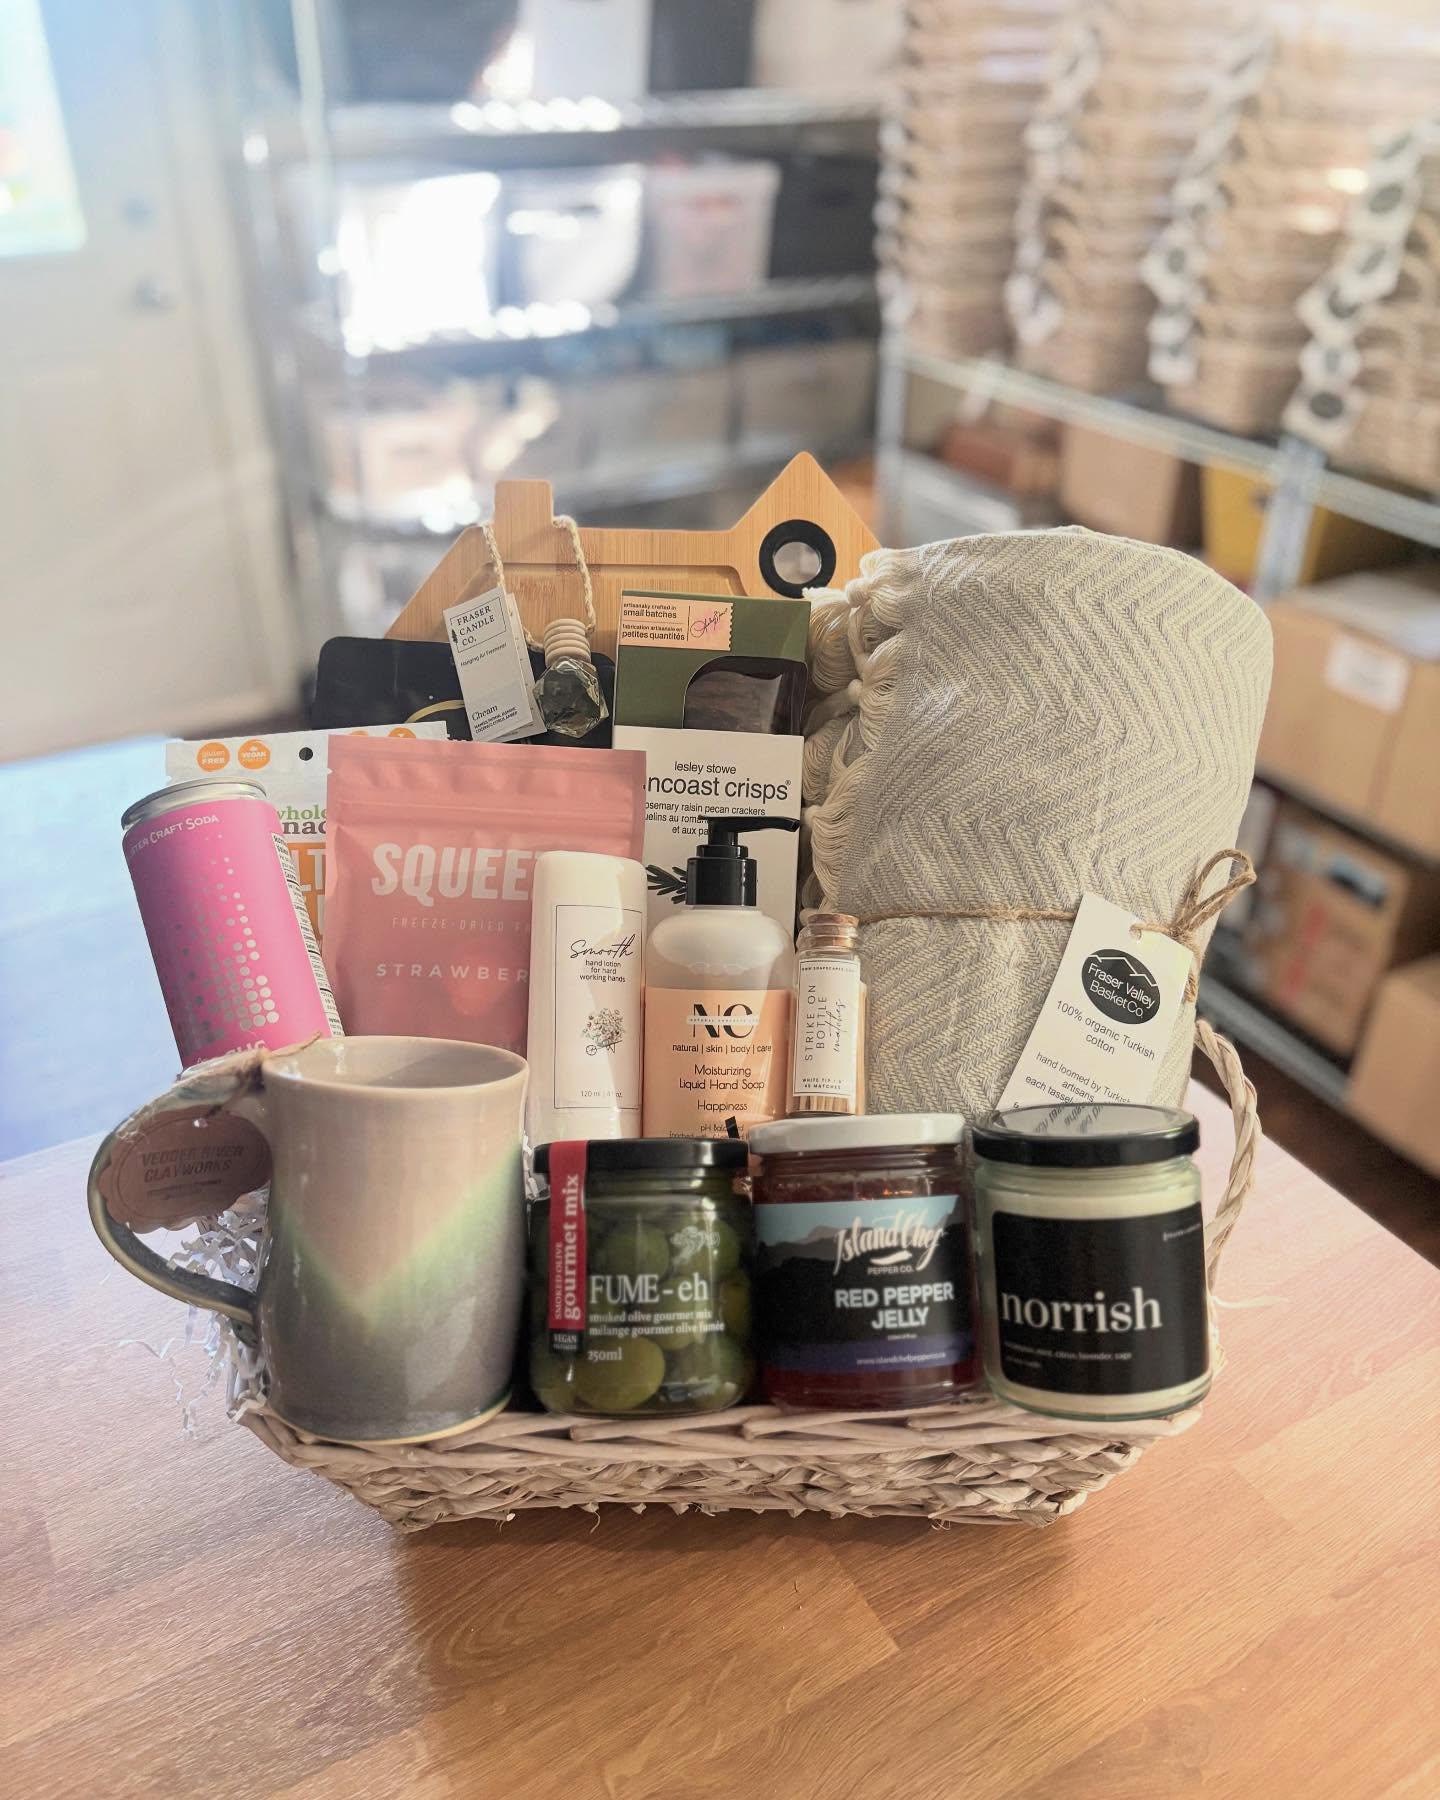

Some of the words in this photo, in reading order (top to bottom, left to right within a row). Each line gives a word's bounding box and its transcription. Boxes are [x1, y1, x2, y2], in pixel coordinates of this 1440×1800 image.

[457, 605, 491, 626] FRASER
[623, 608, 644, 617] small
[646, 610, 677, 618] batches
[459, 614, 495, 636] CANDLE
[462, 636, 477, 646] CO.
[622, 630, 648, 639] petites
[649, 632, 685, 641] quantités
[674, 760, 704, 775] lesley
[706, 763, 737, 775] stowe
[644, 776, 719, 796] ncoast
[645, 801, 680, 812] osemary
[681, 802, 703, 813] raisin
[704, 805, 730, 814] pecan
[731, 806, 766, 816] crackers
[282, 820, 326, 835] nac
[668, 814, 679, 823] au
[149, 822, 184, 844] CRAFT
[185, 814, 220, 830] SODA
[672, 825, 680, 834] et
[682, 826, 697, 835] aux
[371, 842, 536, 907] SQUEE
[570, 933, 636, 959] Smooth
[375, 963, 530, 982] STRAWBER
[585, 959, 603, 967] hand
[604, 960, 622, 968] lotion
[590, 966, 600, 974] for
[602, 967, 617, 975] hard
[580, 974, 606, 982] working
[608, 974, 626, 983] hands
[1087, 962, 1124, 990] Fraser
[1126, 982, 1156, 1009] Valley
[808, 984, 816, 1004] ON
[816, 996, 828, 1050] BOTTLE
[1056, 1000, 1084, 1022] 100%
[1085, 1016, 1120, 1042] organic
[1123, 1034, 1155, 1060] Turkish
[804, 1012, 816, 1062] STRIKE
[1086, 1033, 1116, 1055] cotton
[672, 1044, 699, 1053] natural
[706, 1044, 724, 1053] skin
[730, 1044, 751, 1055] body
[756, 1044, 772, 1052] care
[694, 1064, 752, 1078] Moisturizing
[1036, 1051, 1058, 1069] hand
[1059, 1064, 1090, 1086] loomed
[1090, 1080, 1102, 1093] by
[679, 1078, 706, 1091] Liquid
[709, 1079, 739, 1090] Hand
[741, 1079, 765, 1091] Soap
[1025, 1075, 1047, 1092] each
[1062, 1080, 1096, 1103] artisans
[697, 1099, 748, 1113] Happiness
[562, 1174, 580, 1215] mix
[833, 1209, 900, 1276] Island
[562, 1217, 582, 1320] gourmet
[868, 1266, 899, 1276] PEPPER
[834, 1288, 880, 1309] RED
[883, 1282, 955, 1306] PEPPER
[589, 1310, 626, 1322] smoked
[628, 1310, 652, 1322] olive
[653, 1310, 694, 1324] gourmet
[696, 1309, 712, 1320] mix
[871, 1306, 930, 1330] JELLY
[1001, 1286, 1164, 1333] norrish
[589, 1324, 630, 1338] mélange
[631, 1324, 674, 1338] gourmet
[675, 1322, 698, 1334] olive
[587, 1346, 622, 1362] 250ml
